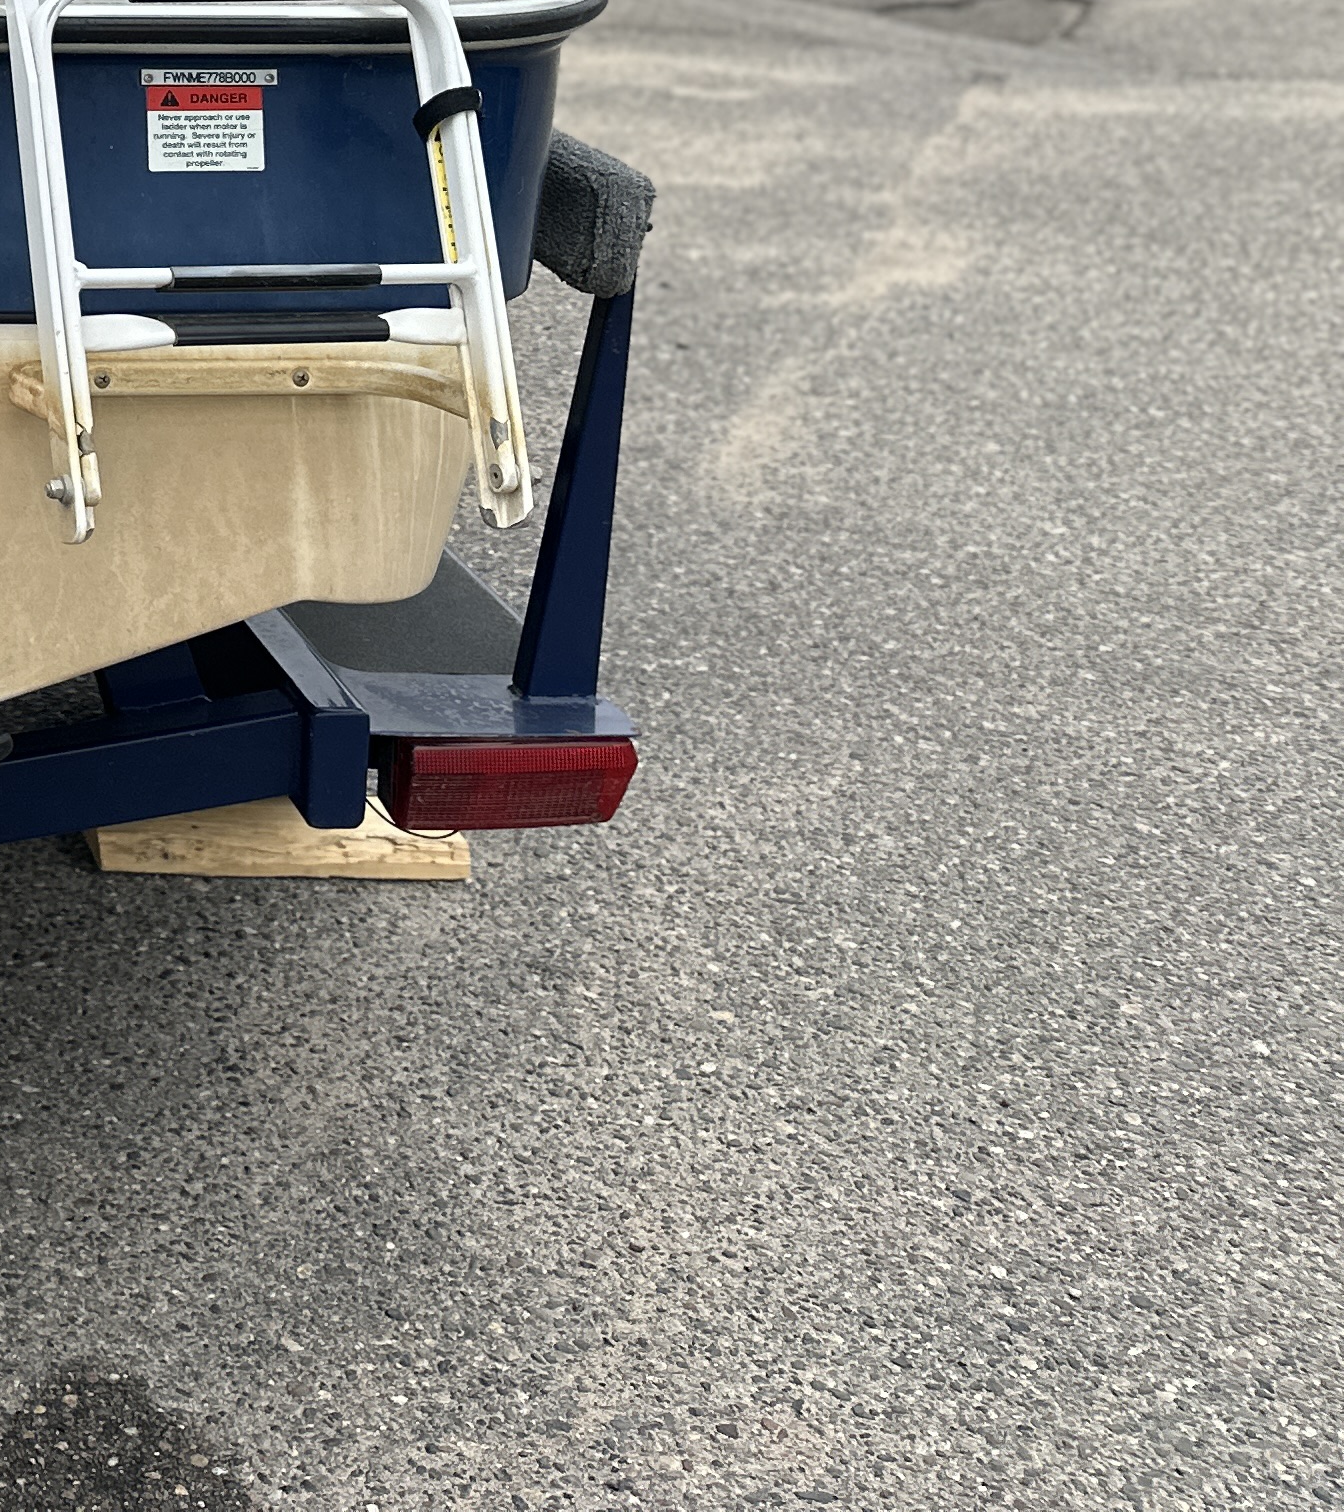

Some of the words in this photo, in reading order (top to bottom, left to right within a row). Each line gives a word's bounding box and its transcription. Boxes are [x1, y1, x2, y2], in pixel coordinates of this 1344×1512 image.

[163, 72, 256, 83] FWNME778B000
[190, 93, 247, 103] DANGER
[184, 114, 222, 122] approach
[153, 132, 187, 141] running.
[222, 132, 245, 140] injury
[215, 150, 247, 158] rotating
